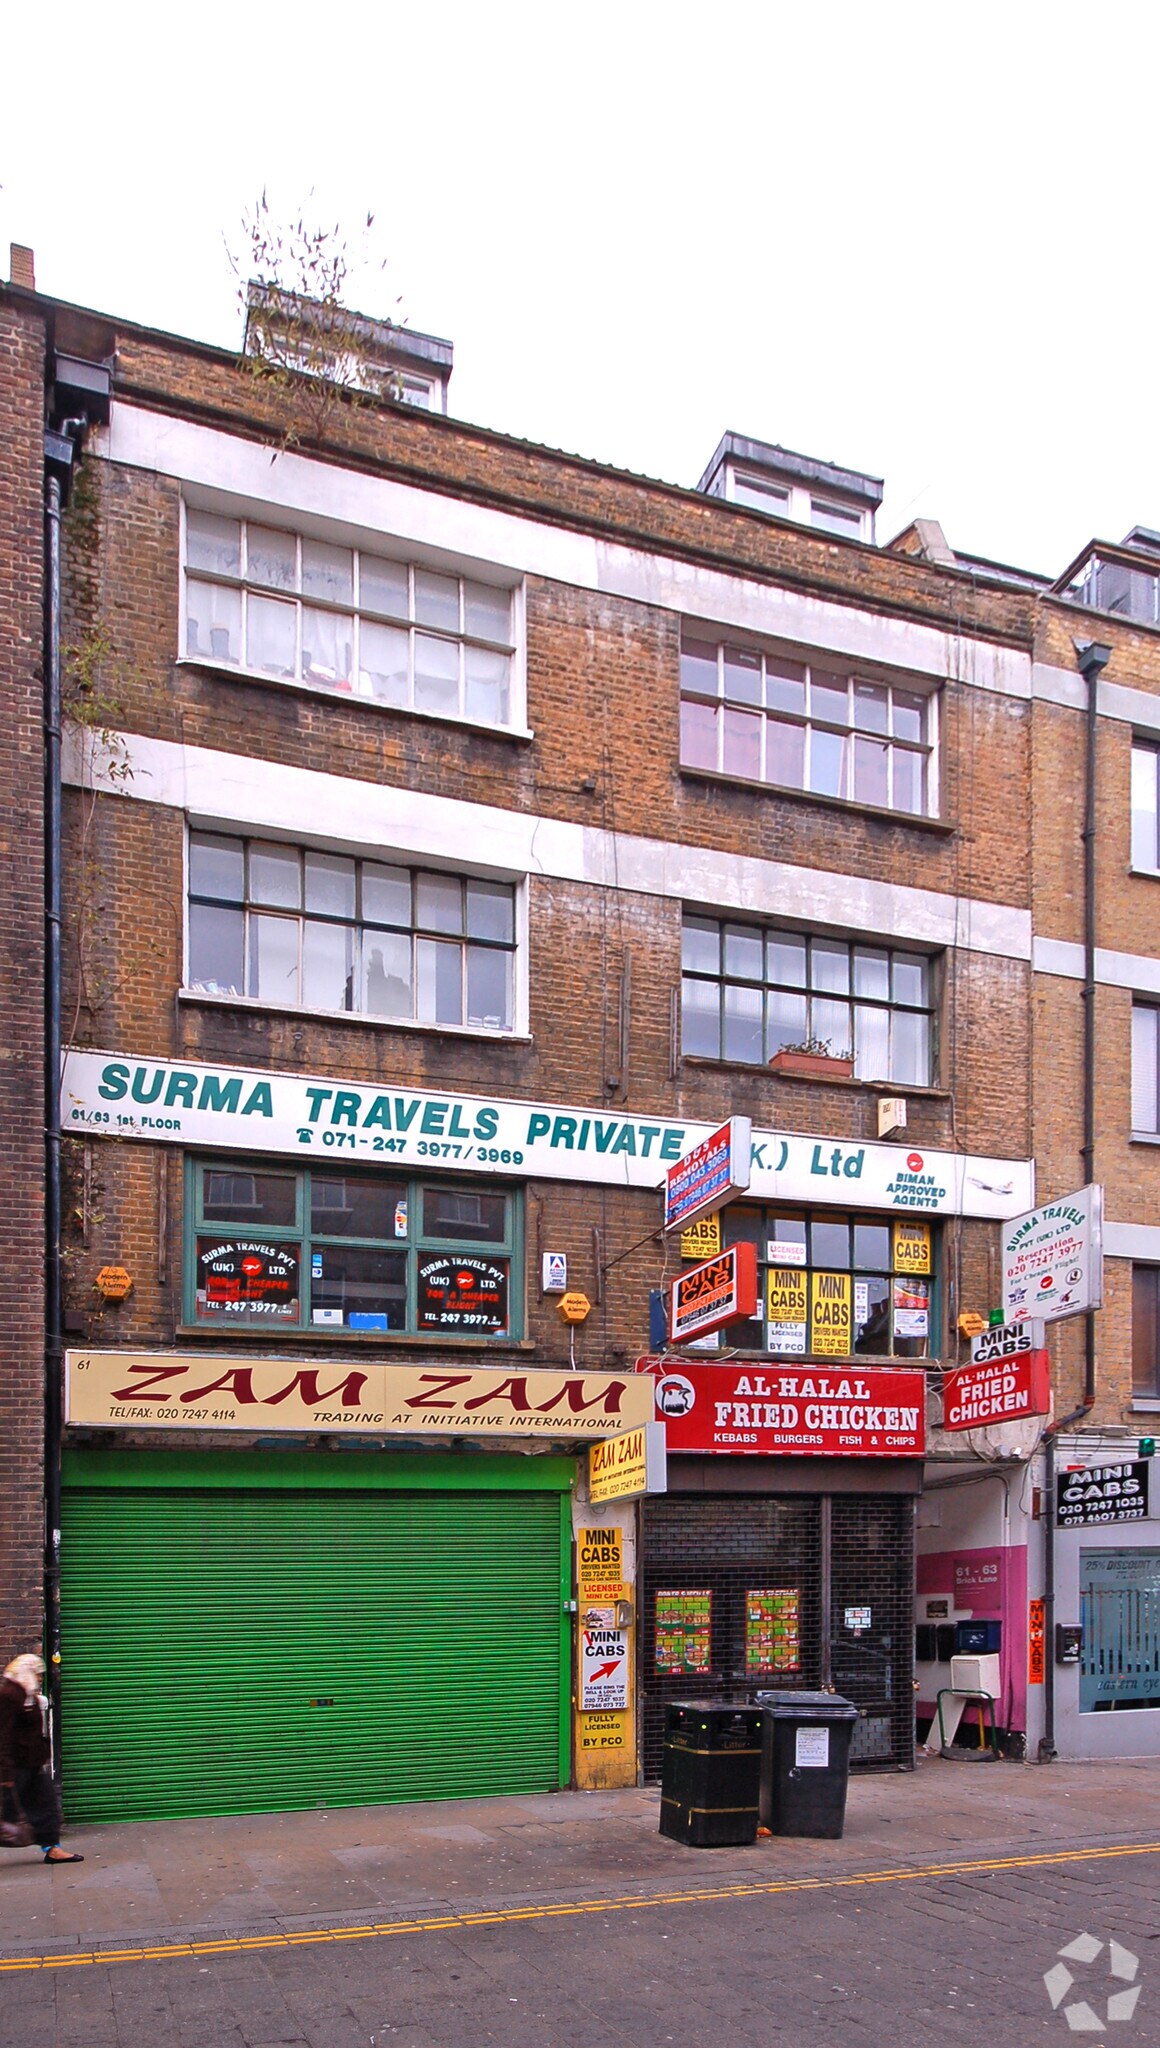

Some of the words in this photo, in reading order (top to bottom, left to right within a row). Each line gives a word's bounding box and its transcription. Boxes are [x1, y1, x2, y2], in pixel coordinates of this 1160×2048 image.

[71, 1108, 110, 1123] 61/63
[117, 1114, 134, 1126] 1st
[141, 1116, 181, 1130] FLOOR
[97, 1063, 273, 1118] SURMA
[305, 1087, 499, 1141] TRAVELS
[526, 1113, 686, 1161] PRIVATE
[750, 1141, 789, 1171] K.)
[810, 1145, 865, 1178] Ltd
[669, 1139, 727, 1189] REMOVALS
[691, 1166, 706, 1182] 043
[896, 1173, 935, 1185] BIMAN
[886, 1183, 946, 1198] APPROVED
[893, 1195, 939, 1208] AGENTS
[1006, 1216, 1039, 1252] SURMA
[1042, 1206, 1086, 1226] TRAVELS
[1019, 1239, 1034, 1250] PVT
[1036, 1231, 1053, 1244] (UK)
[1056, 1224, 1071, 1235] LTD
[201, 1244, 234, 1264] SURMA
[236, 1242, 276, 1256] TRAVELS
[277, 1252, 296, 1269] PVT.
[770, 1246, 804, 1254] LICENSED
[896, 1242, 928, 1260] CABS
[1017, 1236, 1074, 1264] Reservation
[1007, 1263, 1026, 1277] 020
[1030, 1252, 1054, 1269] 7247
[1058, 1241, 1083, 1259] 3977
[212, 1262, 234, 1272] (UK)
[268, 1266, 288, 1275] LTD.
[420, 1259, 450, 1278] SURMA
[450, 1258, 487, 1271] TRAVELS
[682, 1255, 730, 1294] MINI
[430, 1276, 450, 1286] (UK)
[480, 1280, 497, 1289] LTD.
[682, 1270, 730, 1304] CAB
[775, 1271, 800, 1289] MINI
[818, 1275, 845, 1299] MINI
[206, 1301, 222, 1309] TEL.
[224, 1301, 247, 1312] 247
[250, 1302, 278, 1313] 3977
[771, 1290, 805, 1308] CABS
[440, 1312, 460, 1324] 247
[462, 1314, 488, 1325] 3977
[814, 1301, 848, 1326] CABS
[775, 1322, 799, 1330] FULLY
[980, 1324, 1024, 1348] MINI
[770, 1342, 782, 1350] BY
[785, 1343, 804, 1351] PCO
[974, 1336, 1031, 1362] CABS
[77, 1360, 90, 1370] 61
[110, 1364, 369, 1406] ZAM
[404, 1374, 628, 1414] ZAM
[733, 1376, 871, 1400] AL-HALAL
[961, 1375, 1016, 1404] FRIED
[109, 1406, 152, 1418] TEL/FAX:
[156, 1408, 178, 1419] 020
[182, 1408, 208, 1420] 7247
[212, 1410, 236, 1420] 4114
[949, 1390, 1028, 1423] CHICKEN
[313, 1412, 384, 1424] TRADING
[392, 1414, 413, 1424] AT
[421, 1414, 504, 1426] INITIATIVE
[509, 1416, 623, 1428] INTERNATIONAL
[714, 1402, 800, 1429] FRIED
[804, 1404, 920, 1432] CHICKEN
[714, 1432, 758, 1444] KEBABS
[774, 1434, 824, 1445] BURGERS
[839, 1435, 862, 1446] FISH
[870, 1436, 878, 1445] &
[885, 1436, 916, 1446] CHIPS
[592, 1442, 615, 1472] ZAM
[618, 1432, 642, 1464] ZAM
[1068, 1464, 1132, 1485] MINI
[1062, 1479, 1140, 1502] CABS
[1058, 1504, 1083, 1515] 020
[1086, 1500, 1112, 1512] 7247
[1116, 1496, 1144, 1508] 1035
[1064, 1516, 1084, 1525] 079
[1087, 1512, 1116, 1522] 4607
[1118, 1508, 1144, 1519] 3737
[586, 1530, 615, 1546] MINI
[581, 1546, 620, 1563] CABS
[956, 1567, 970, 1577] 61
[982, 1564, 998, 1575] 63
[1085, 1560, 1106, 1570] 25%
[1106, 1560, 1151, 1570] DISCOUNT
[584, 1584, 623, 1592] LICENSED
[956, 1576, 976, 1584] Brick
[590, 1631, 621, 1642] MINI
[585, 1645, 626, 1658] CABS
[584, 1723, 620, 1731] LICENSED
[588, 1714, 616, 1723] FULLY
[584, 1738, 598, 1746] BY
[601, 1736, 622, 1745] PCO
